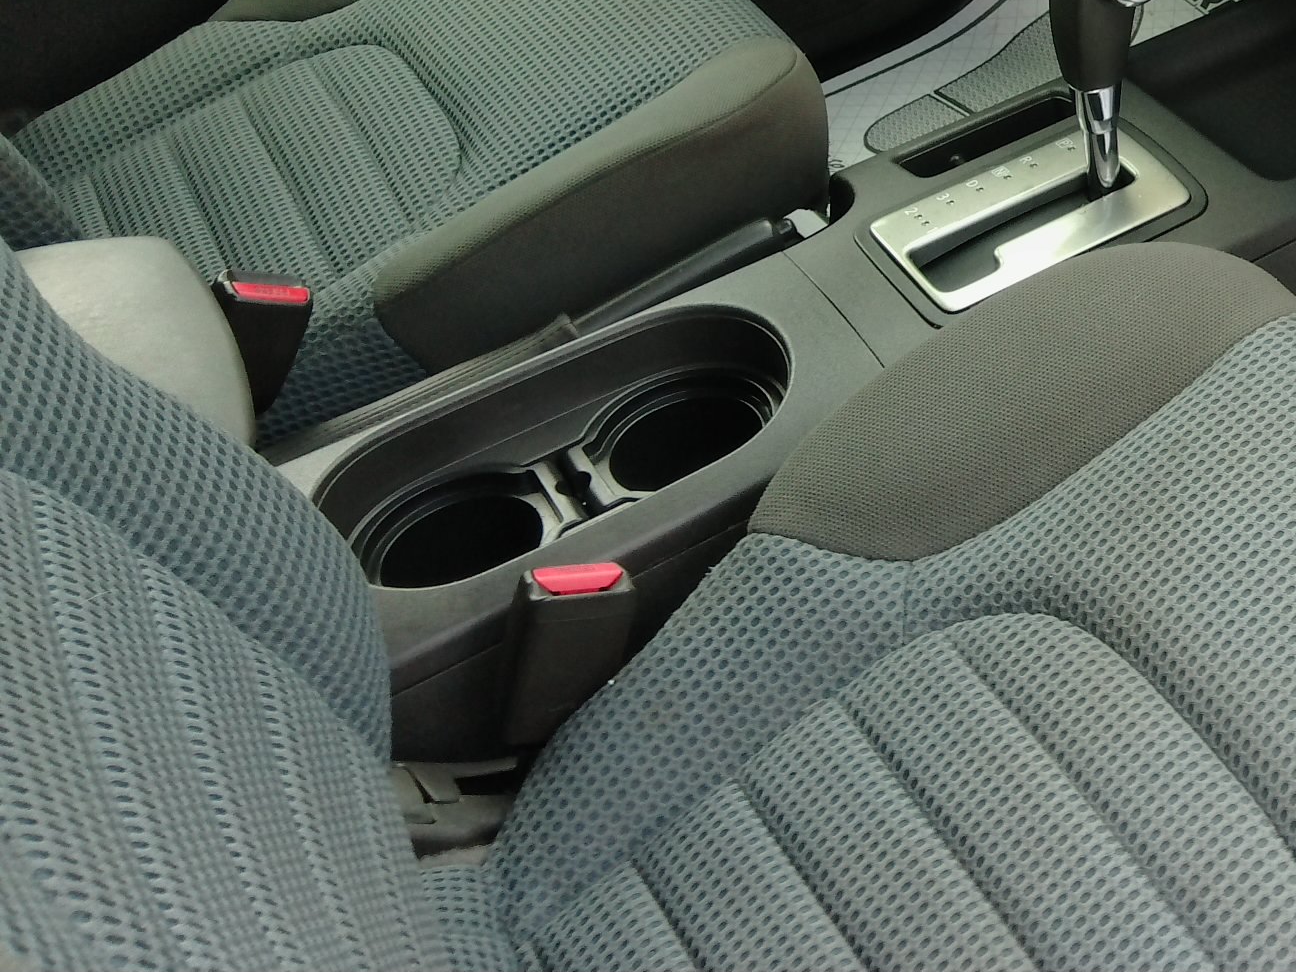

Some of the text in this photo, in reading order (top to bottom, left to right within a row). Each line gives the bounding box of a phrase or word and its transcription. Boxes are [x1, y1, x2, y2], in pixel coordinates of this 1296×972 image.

[1019, 155, 1033, 165] R
[965, 179, 979, 189] D
[936, 193, 950, 202] 3
[904, 206, 919, 216] 2
